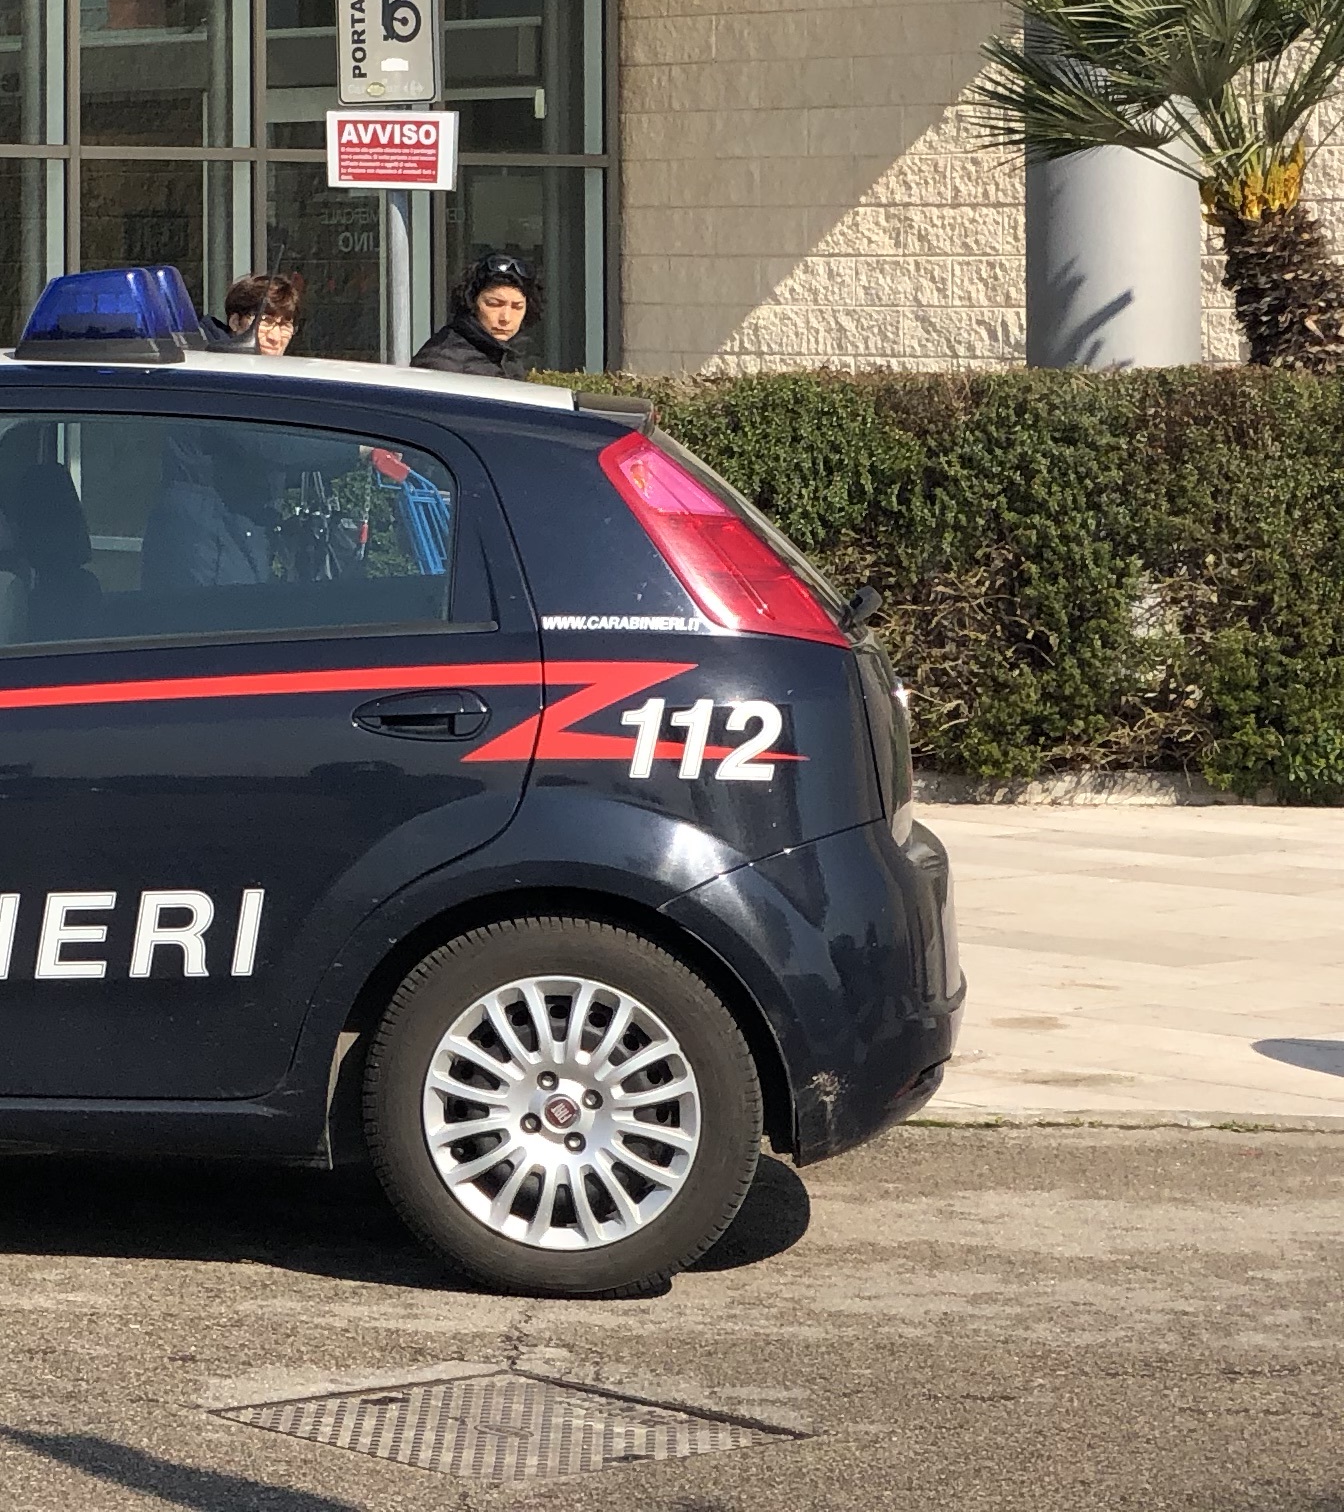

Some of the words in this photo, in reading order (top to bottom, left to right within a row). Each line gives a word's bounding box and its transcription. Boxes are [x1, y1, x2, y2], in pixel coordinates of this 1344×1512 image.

[340, 123, 437, 145] AVVISO
[541, 616, 701, 632] WWW.CARABINIERI.IT
[620, 698, 783, 782] 112
